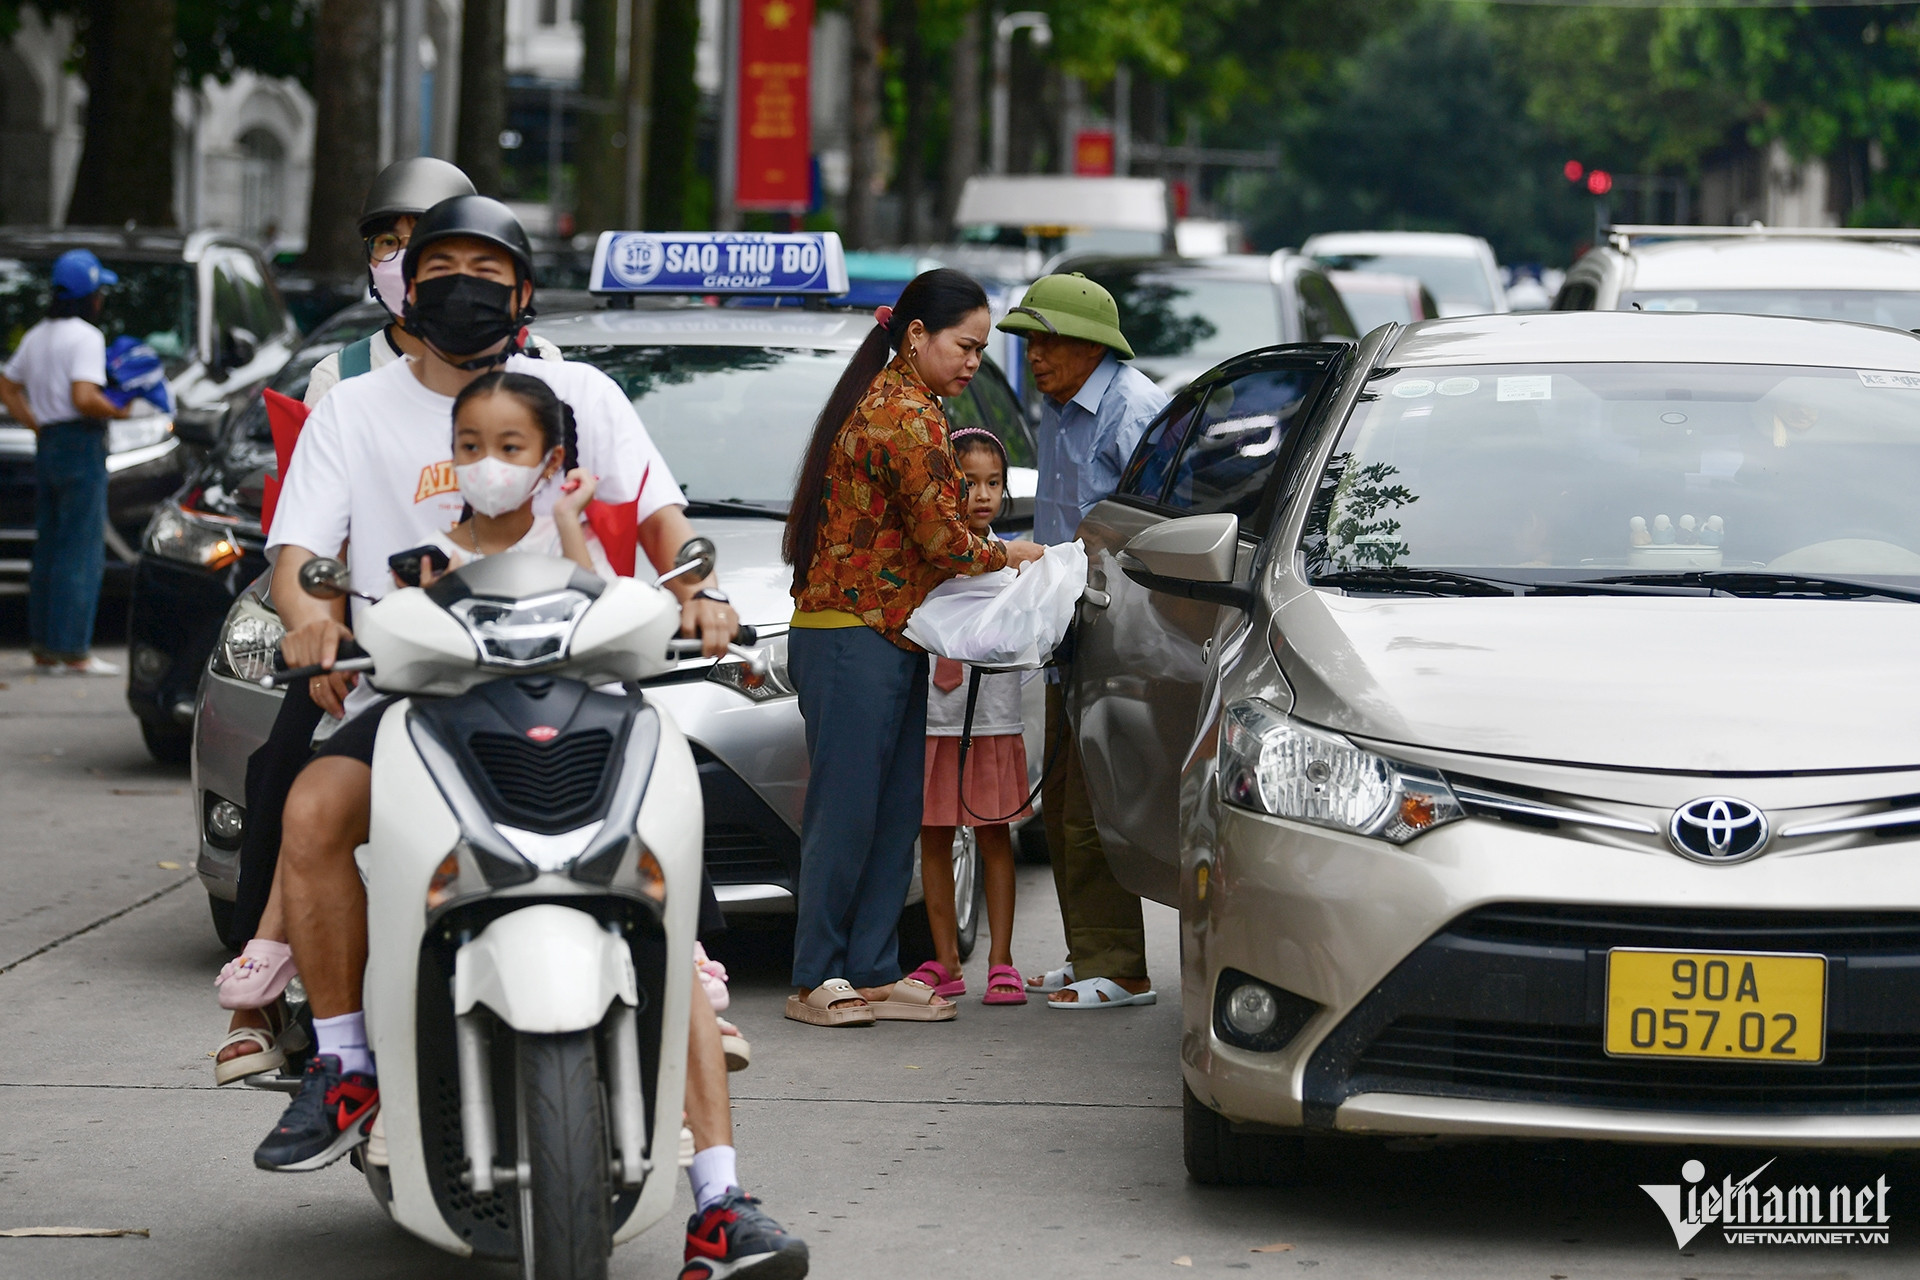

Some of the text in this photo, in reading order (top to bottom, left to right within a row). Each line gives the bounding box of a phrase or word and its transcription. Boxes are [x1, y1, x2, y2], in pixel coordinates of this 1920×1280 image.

[665, 243, 719, 274] SAO
[703, 275, 772, 288] GROUP
[1672, 959, 1759, 1003] 90A
[1630, 1007, 1797, 1054] 057.02
